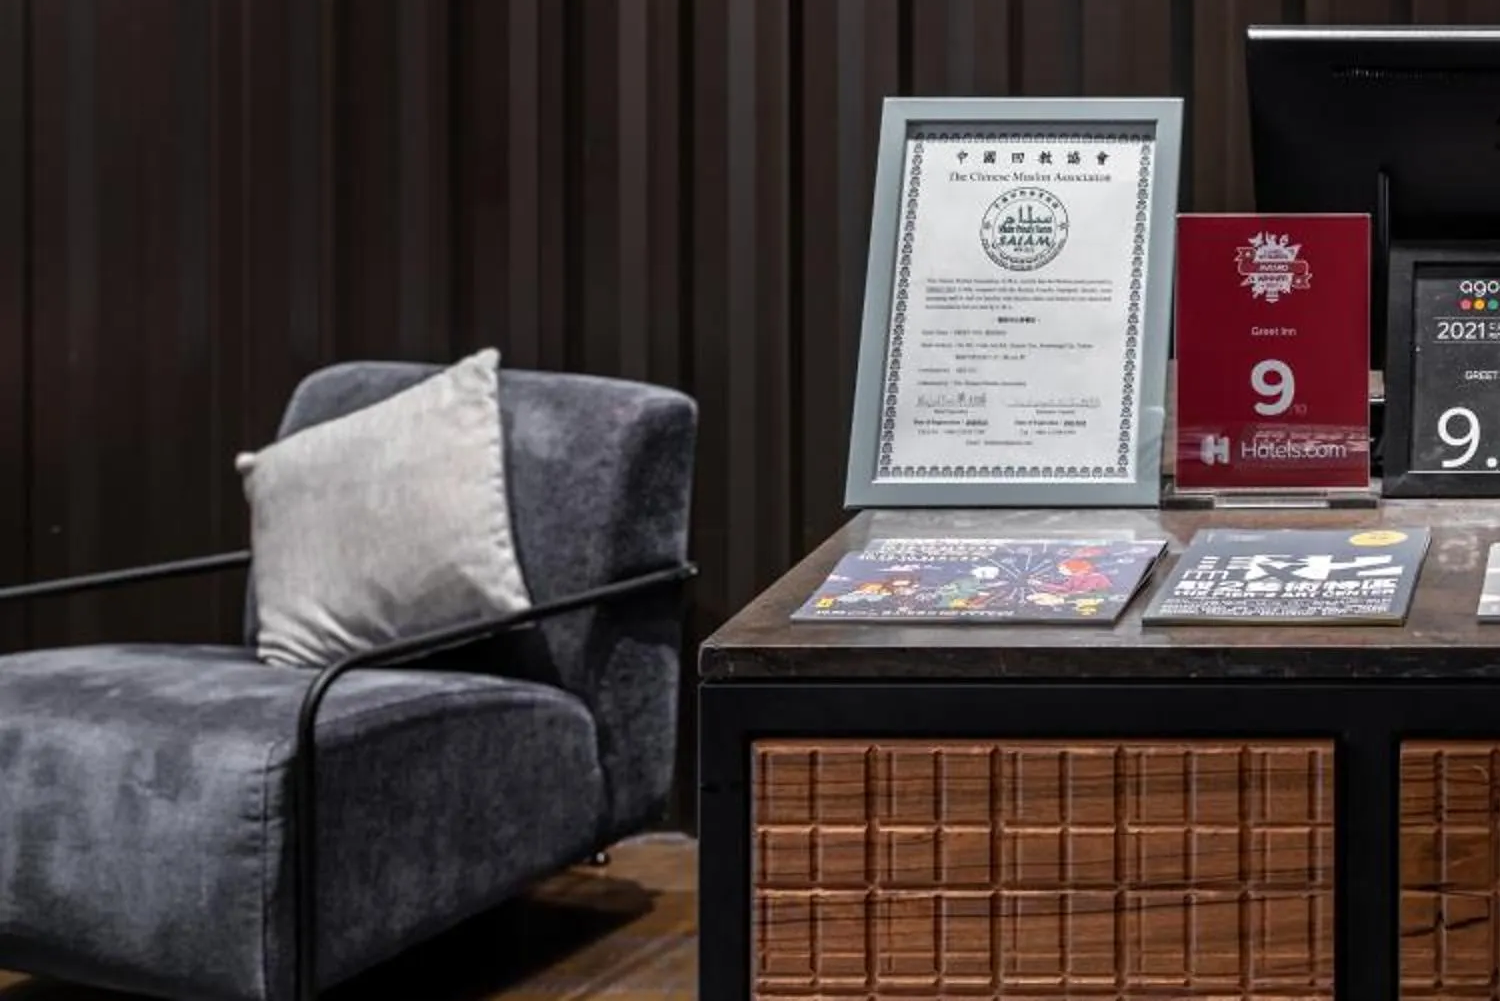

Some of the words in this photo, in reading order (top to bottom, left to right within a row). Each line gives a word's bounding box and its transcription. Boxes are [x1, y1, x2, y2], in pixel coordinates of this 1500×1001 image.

[1251, 326, 1279, 336] Greet
[1281, 326, 1297, 336] Inn
[1437, 322, 1485, 340] 2021
[1465, 370, 1499, 380] GREET
[1251, 359, 1295, 416] 9
[1241, 441, 1347, 459] Hotels.com
